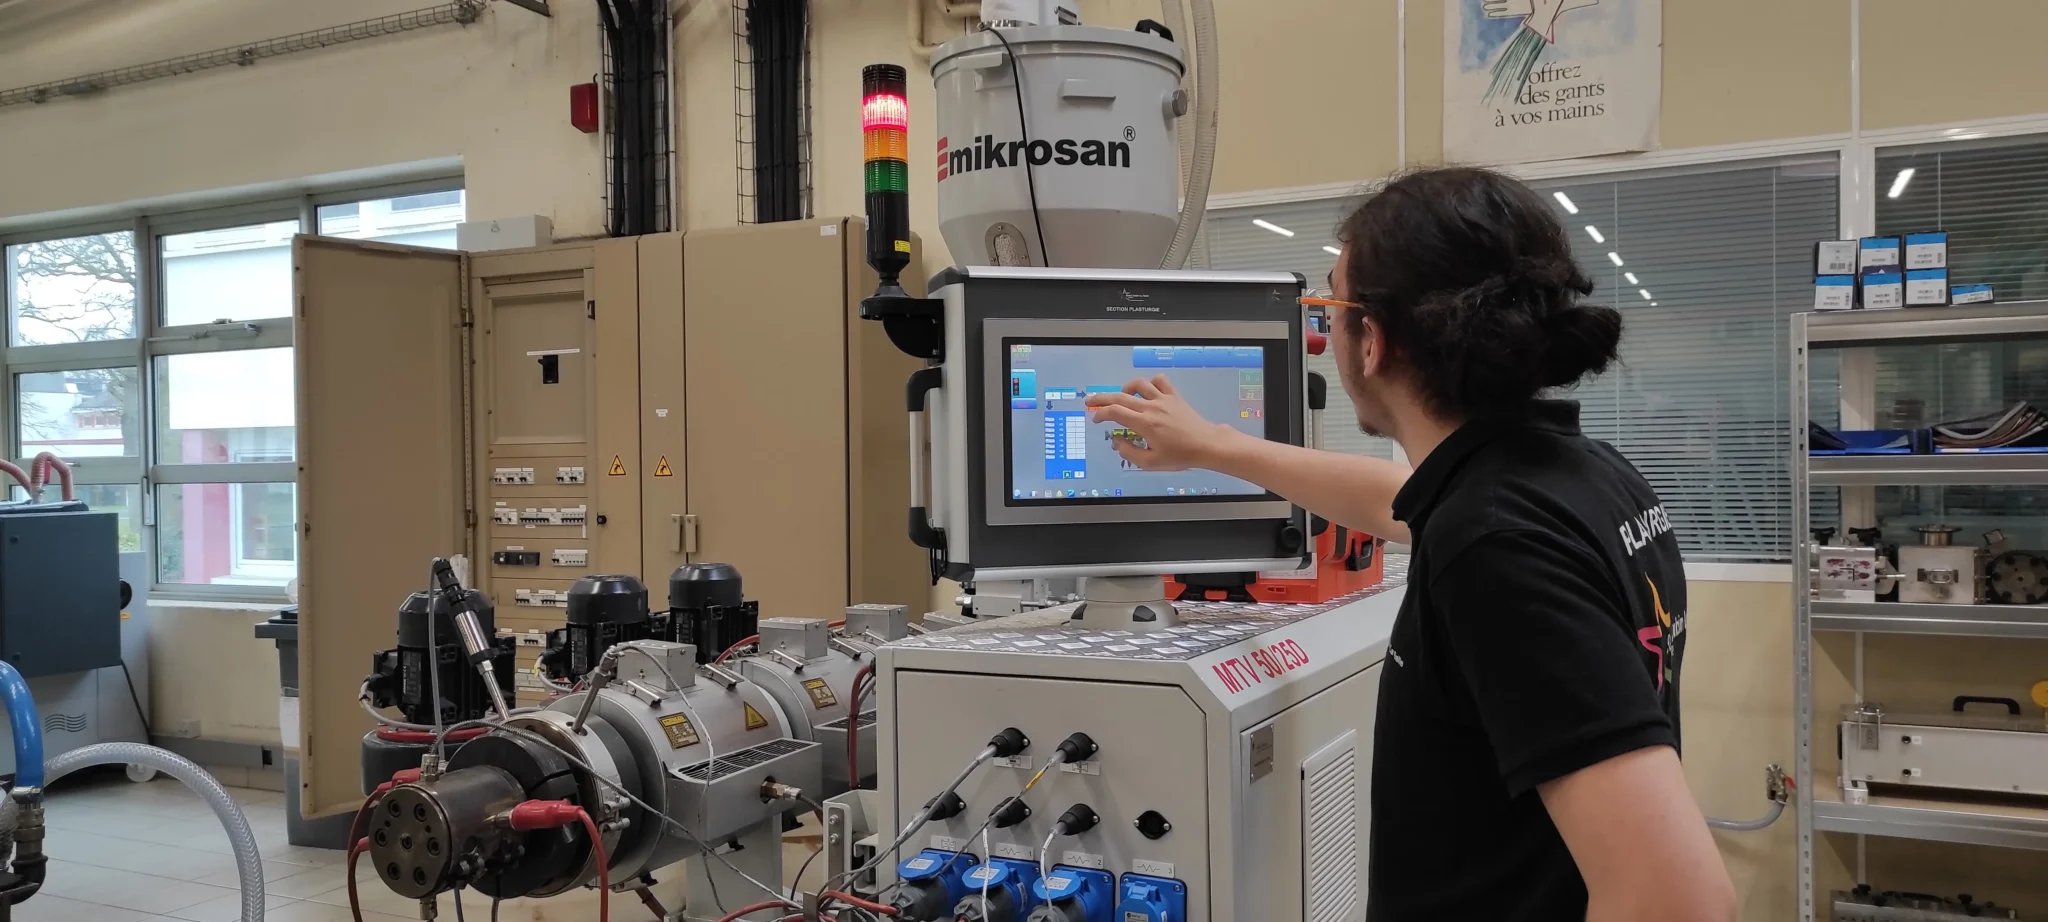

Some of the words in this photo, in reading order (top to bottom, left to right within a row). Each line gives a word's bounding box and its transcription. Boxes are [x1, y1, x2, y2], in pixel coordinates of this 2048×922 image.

[1528, 61, 1582, 84] offrez
[1519, 84, 1550, 105] des
[1555, 82, 1605, 106] gants
[1494, 108, 1506, 127] à
[1510, 111, 1542, 125] vos
[1548, 100, 1605, 122] mains
[1211, 657, 1261, 694] MTV
[1250, 638, 1310, 679] 50/25D
